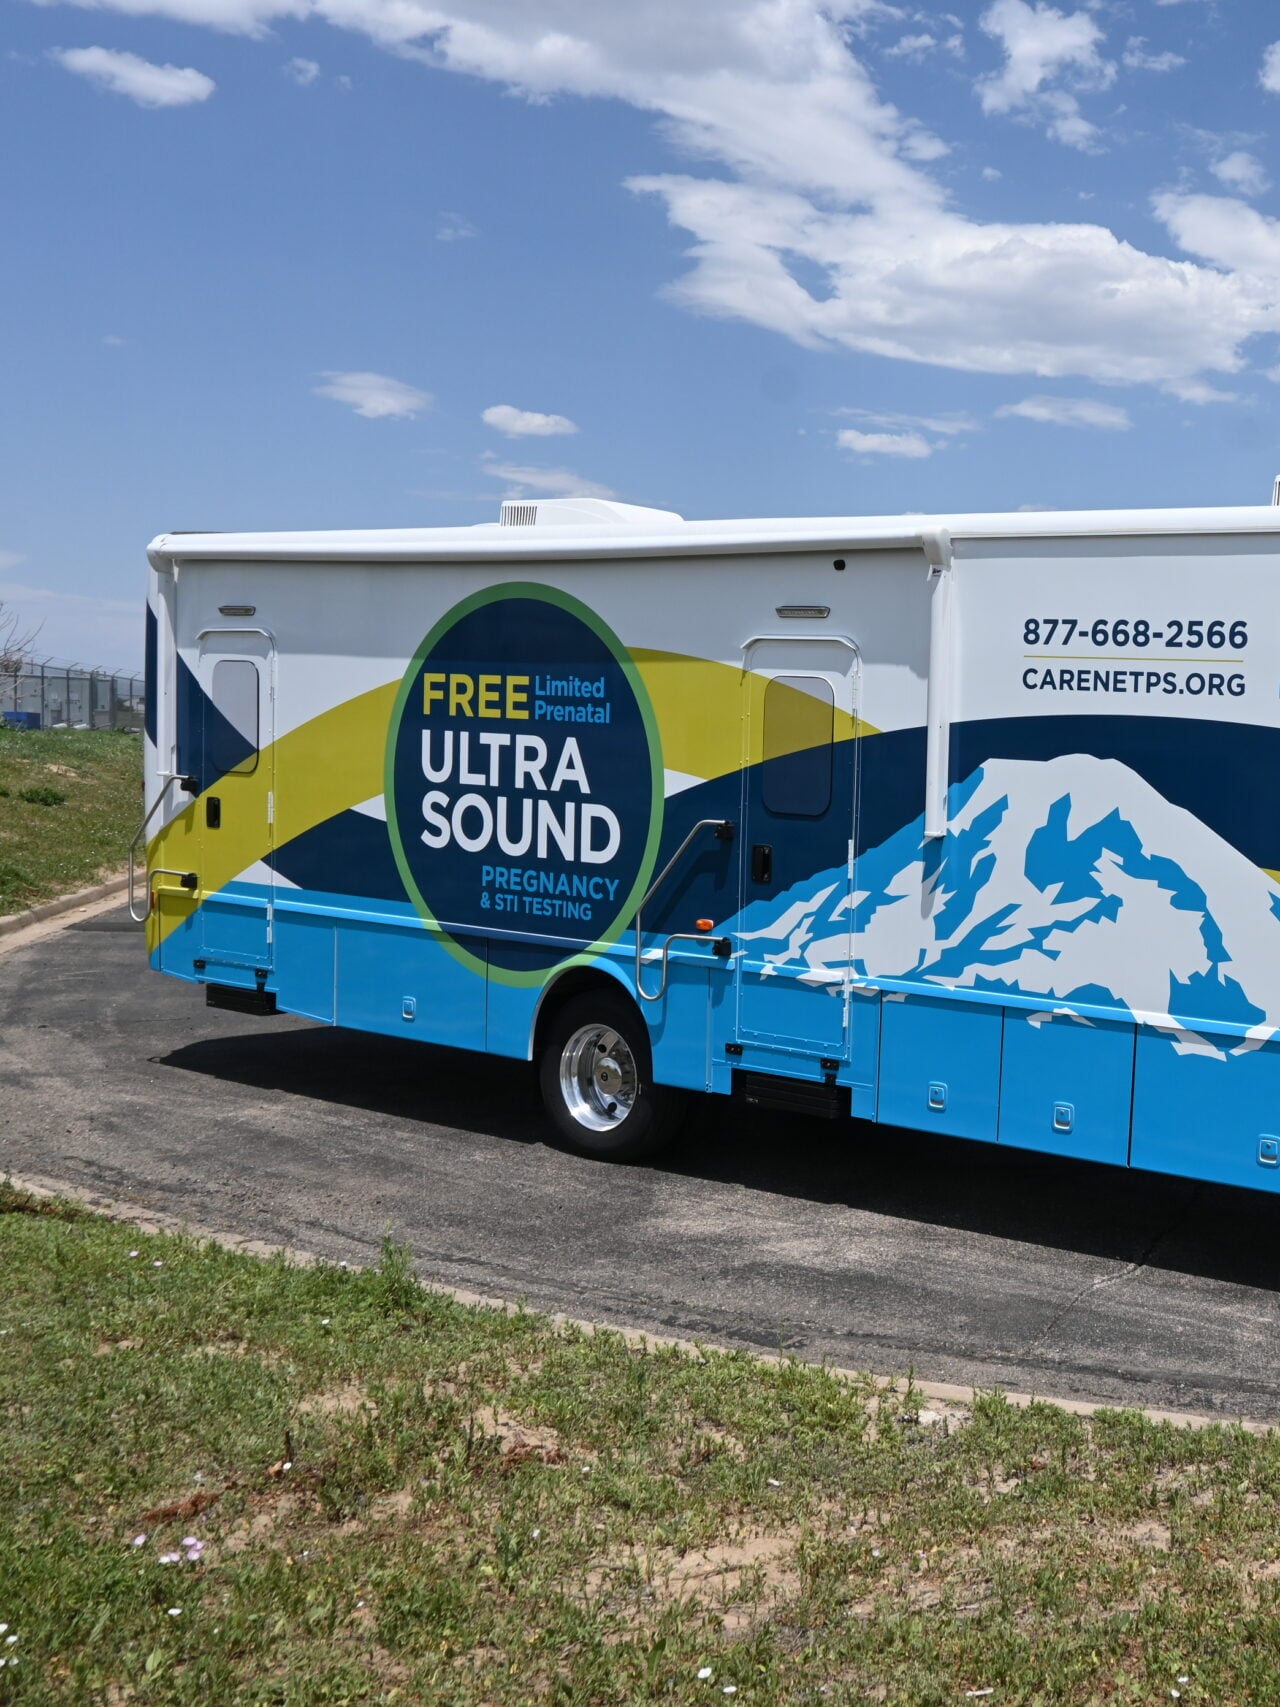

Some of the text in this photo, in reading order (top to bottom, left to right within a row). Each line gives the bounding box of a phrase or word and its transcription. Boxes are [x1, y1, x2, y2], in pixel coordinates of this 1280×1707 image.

[1023, 618, 1249, 650] 877-668-2566
[423, 672, 530, 719] FREE
[535, 674, 605, 698] Limited
[1022, 667, 1246, 697] CARENETPS.ORG
[534, 700, 611, 724] Prenatal
[421, 729, 591, 794] ULTRA
[420, 790, 621, 864] SOUND
[481, 865, 620, 901] PREGNANCY
[480, 891, 592, 921] & STI TESTING
